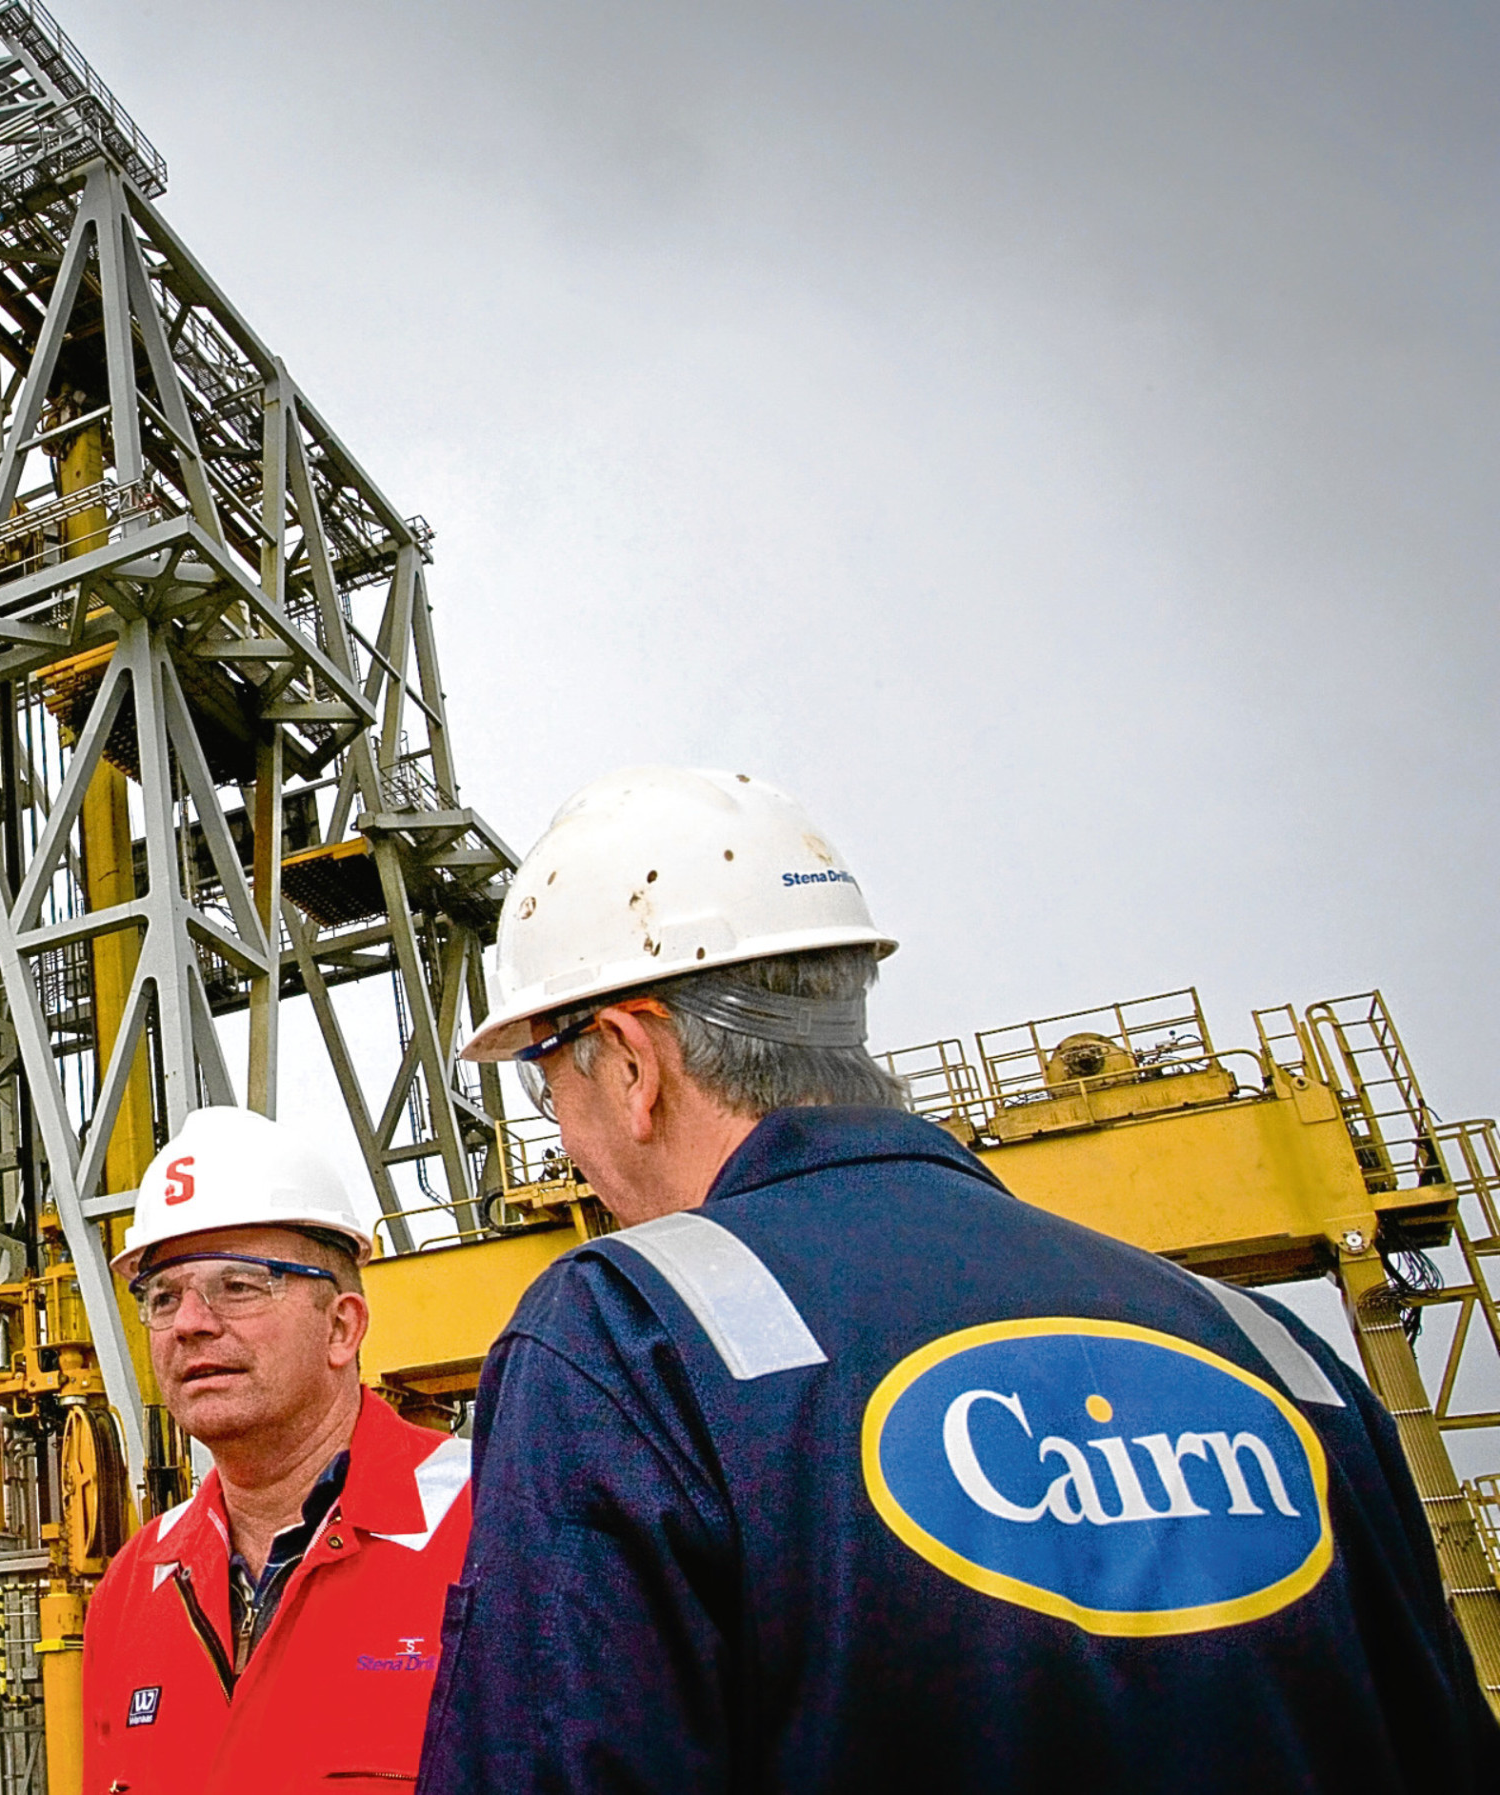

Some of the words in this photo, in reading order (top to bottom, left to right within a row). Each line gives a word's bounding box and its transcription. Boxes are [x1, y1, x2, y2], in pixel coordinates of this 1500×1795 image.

[782, 871, 828, 887] Stena
[164, 1155, 195, 1207] S
[941, 1388, 1301, 1526] Cairn
[356, 1654, 403, 1671] Stena
[135, 1691, 155, 1712] W
